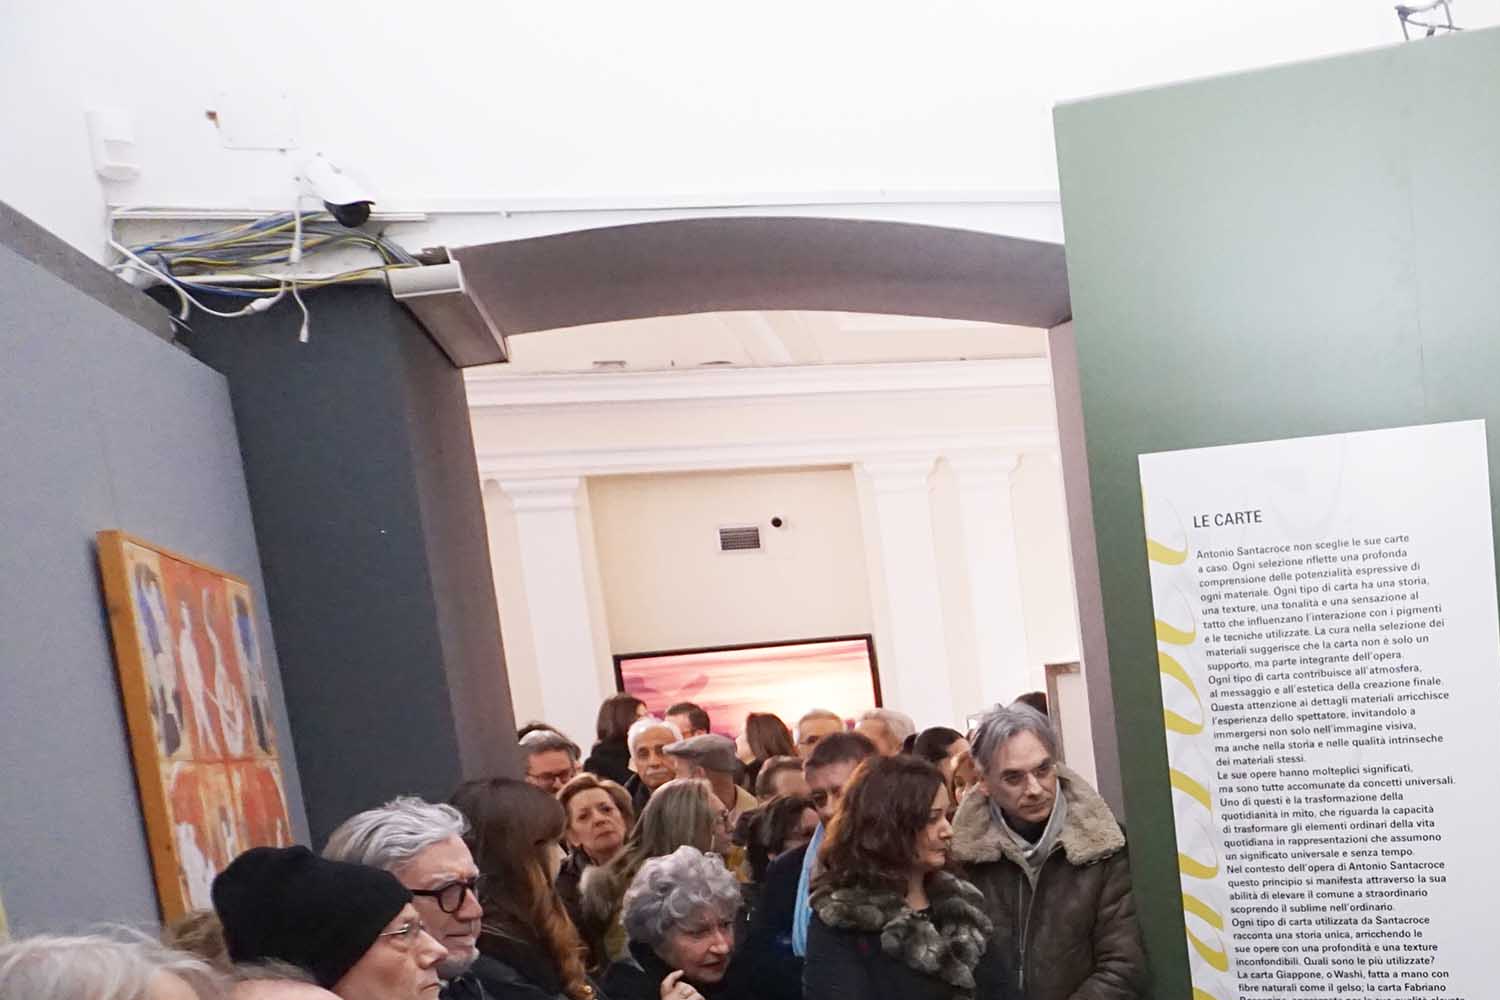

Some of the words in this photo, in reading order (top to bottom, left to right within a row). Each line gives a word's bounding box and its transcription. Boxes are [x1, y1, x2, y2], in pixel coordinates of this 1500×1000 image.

[1194, 515, 1210, 528] LE
[1214, 510, 1262, 526] CARTE
[1197, 550, 1234, 558] Antonio
[1237, 546, 1290, 556] Santacroce
[1315, 540, 1349, 550] sceglie
[1203, 621, 1226, 629] tatto
[1228, 619, 1245, 627] che
[1248, 616, 1303, 625] influenzano
[1396, 605, 1441, 617] pigmenti
[1208, 674, 1231, 686] Ogni
[1233, 674, 1252, 684] tipo
[1254, 673, 1264, 682] di
[1293, 669, 1352, 679] contribuisce
[1270, 713, 1294, 722] dello
[1352, 707, 1407, 717] invitandolo
[1214, 728, 1266, 739] immergersi
[1290, 726, 1310, 736] solo
[1216, 757, 1230, 766] dei
[1233, 755, 1274, 765] materiali
[1217, 771, 1228, 780] Le
[1250, 771, 1277, 780] opere
[1312, 766, 1360, 776] molteplici
[1287, 782, 1346, 790] accomunate
[1348, 780, 1360, 788] da
[1363, 778, 1402, 787] concetti
[1234, 824, 1288, 833] trasformare
[1291, 823, 1302, 833] gli
[1305, 822, 1347, 831] elementi
[1350, 820, 1387, 829] ordinari
[1390, 819, 1413, 828] della
[1416, 819, 1435, 827] vita
[1224, 838, 1274, 848] quotidiana
[1288, 835, 1368, 846] rappresentazioni
[1370, 835, 1388, 843] che
[1227, 865, 1242, 874] Nel
[1337, 863, 1347, 871] di
[1390, 861, 1445, 870] Santacroce
[1228, 880, 1260, 888] questo
[1262, 878, 1303, 887] principio
[1316, 876, 1363, 885] manifesta
[1232, 918, 1254, 928] Ogni
[1256, 918, 1275, 928] tipo
[1315, 917, 1358, 925] utilizzata
[1361, 917, 1373, 925] da
[1376, 916, 1430, 925] Santacroce
[1296, 930, 1322, 939] storia
[1355, 930, 1411, 938] arricchendo
